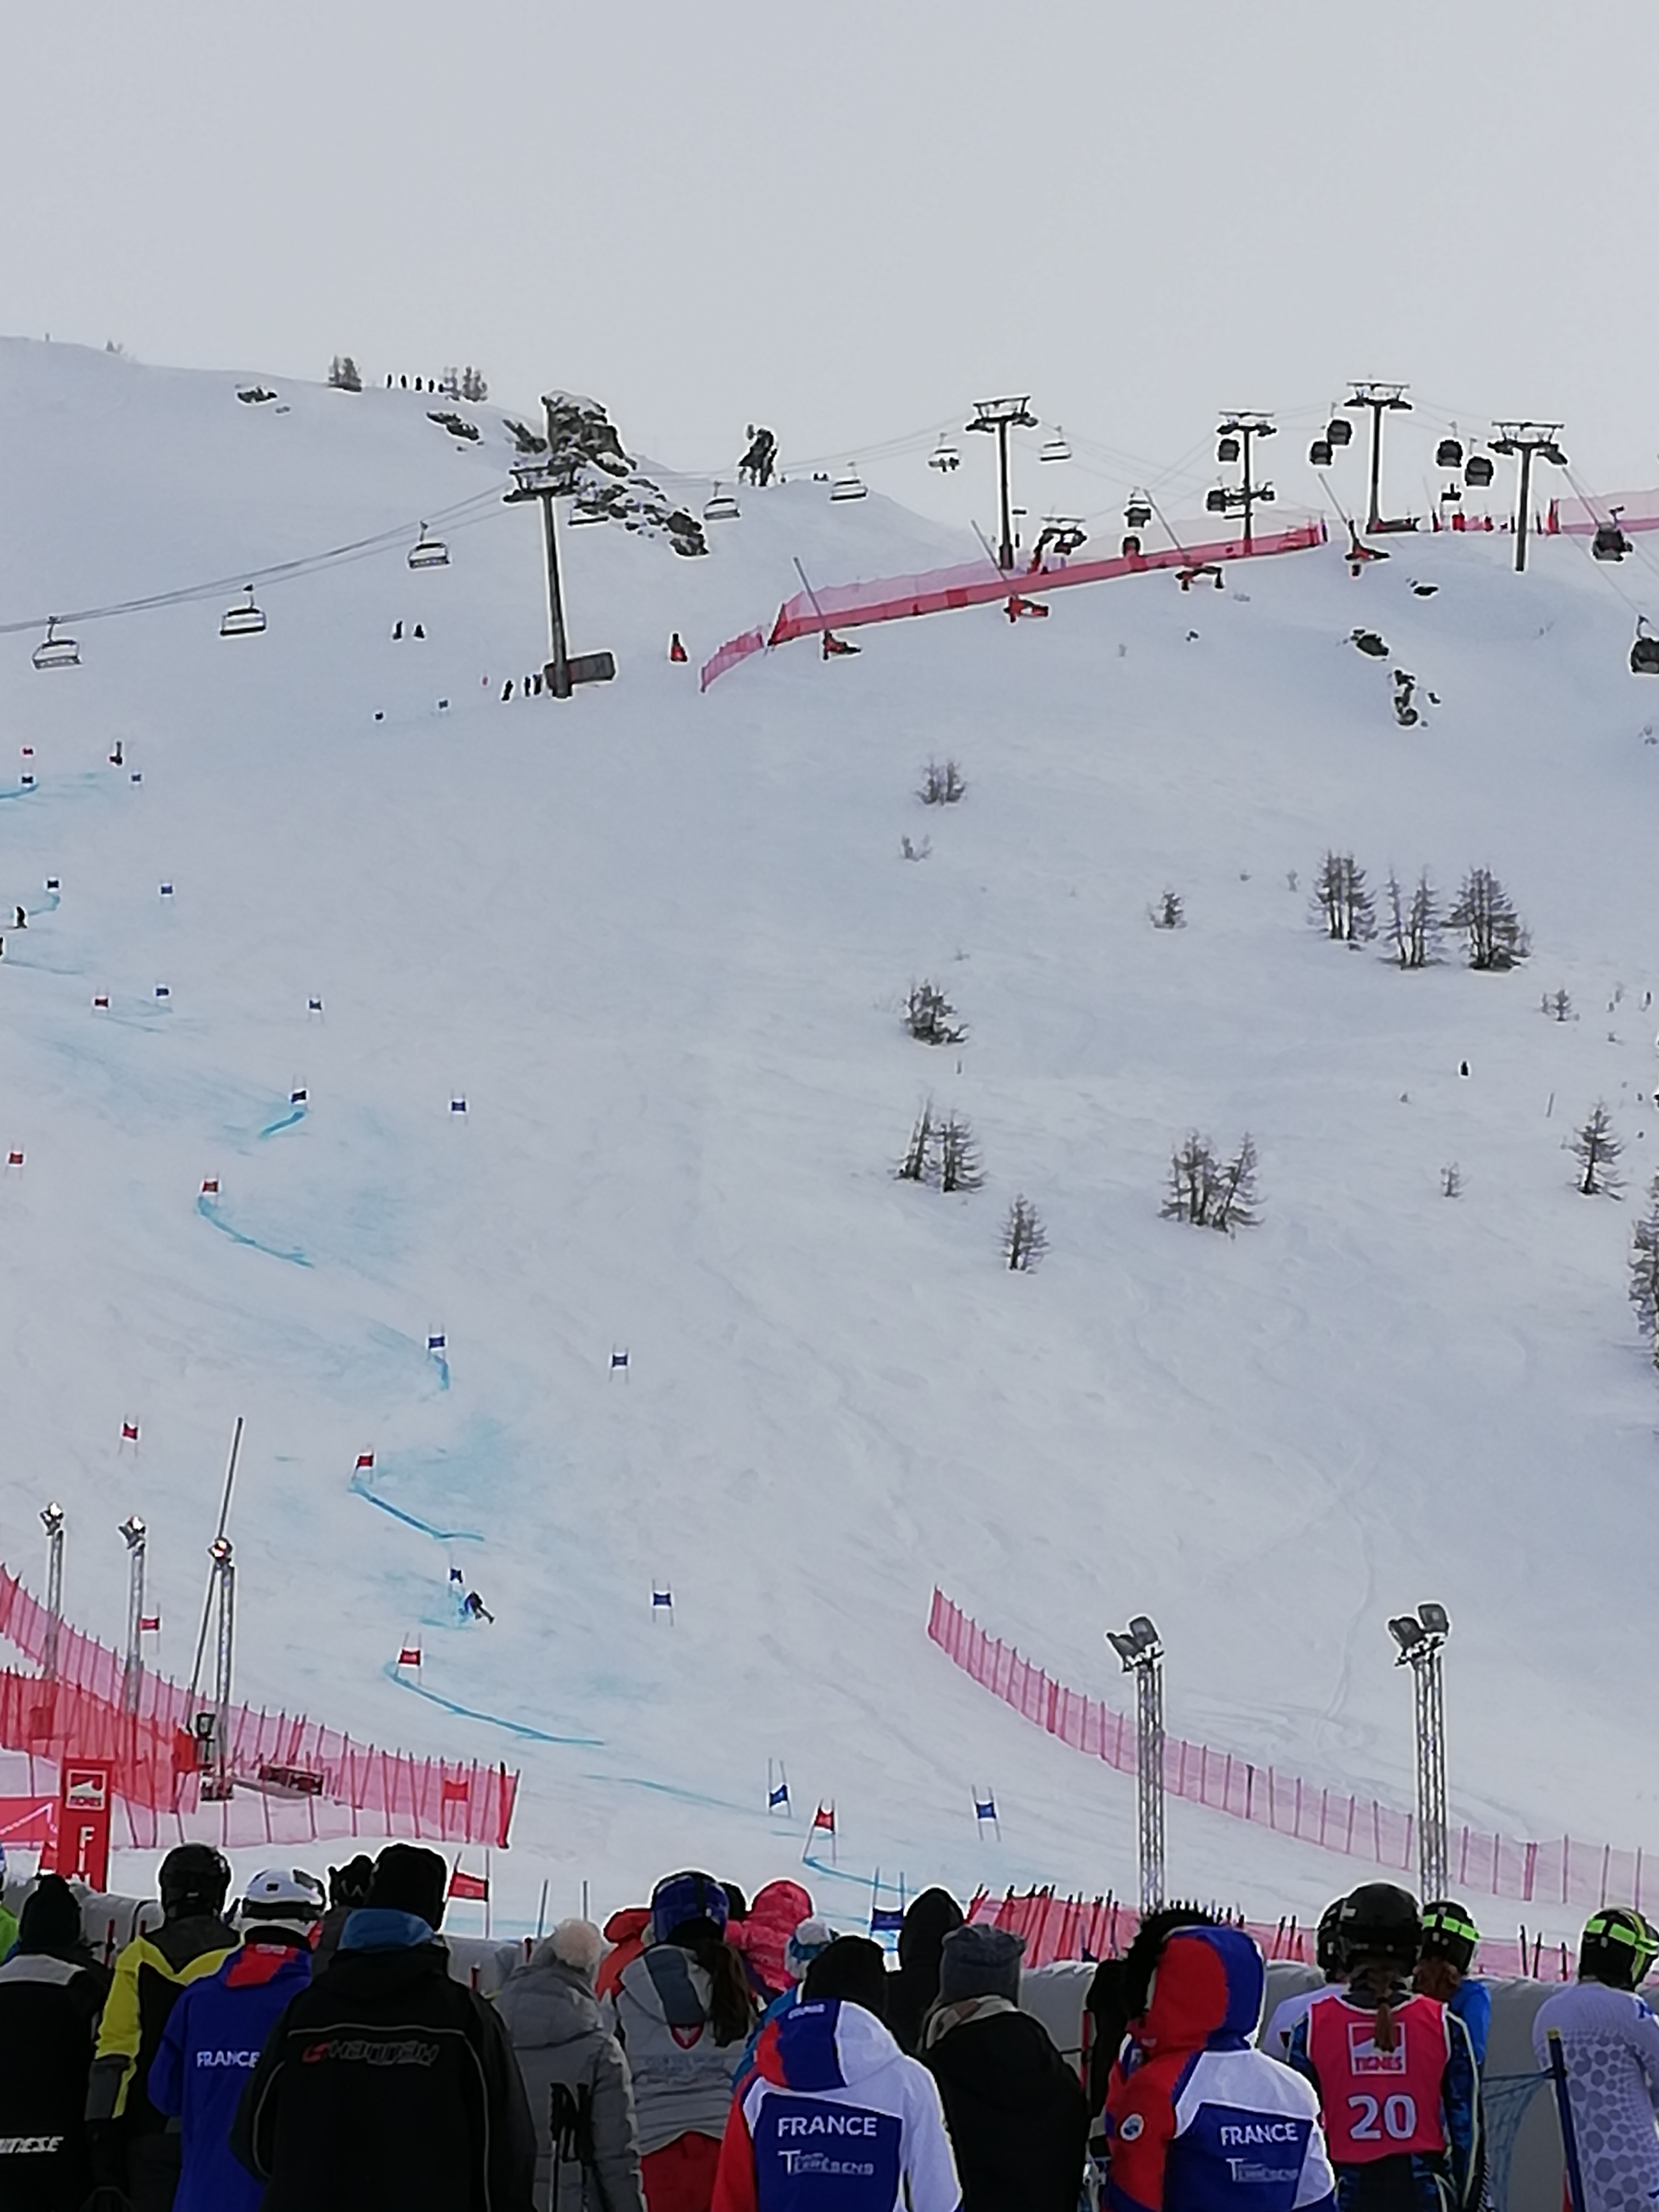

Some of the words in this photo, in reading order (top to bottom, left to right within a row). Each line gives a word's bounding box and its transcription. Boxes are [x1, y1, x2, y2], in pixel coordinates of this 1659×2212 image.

[196, 2050, 261, 2068] FRANCE
[1355, 2056, 1403, 2072] TIGNES
[778, 2115, 878, 2137] FRANCE
[1348, 2094, 1417, 2140] 20
[1221, 2122, 1299, 2146] FRANCE
